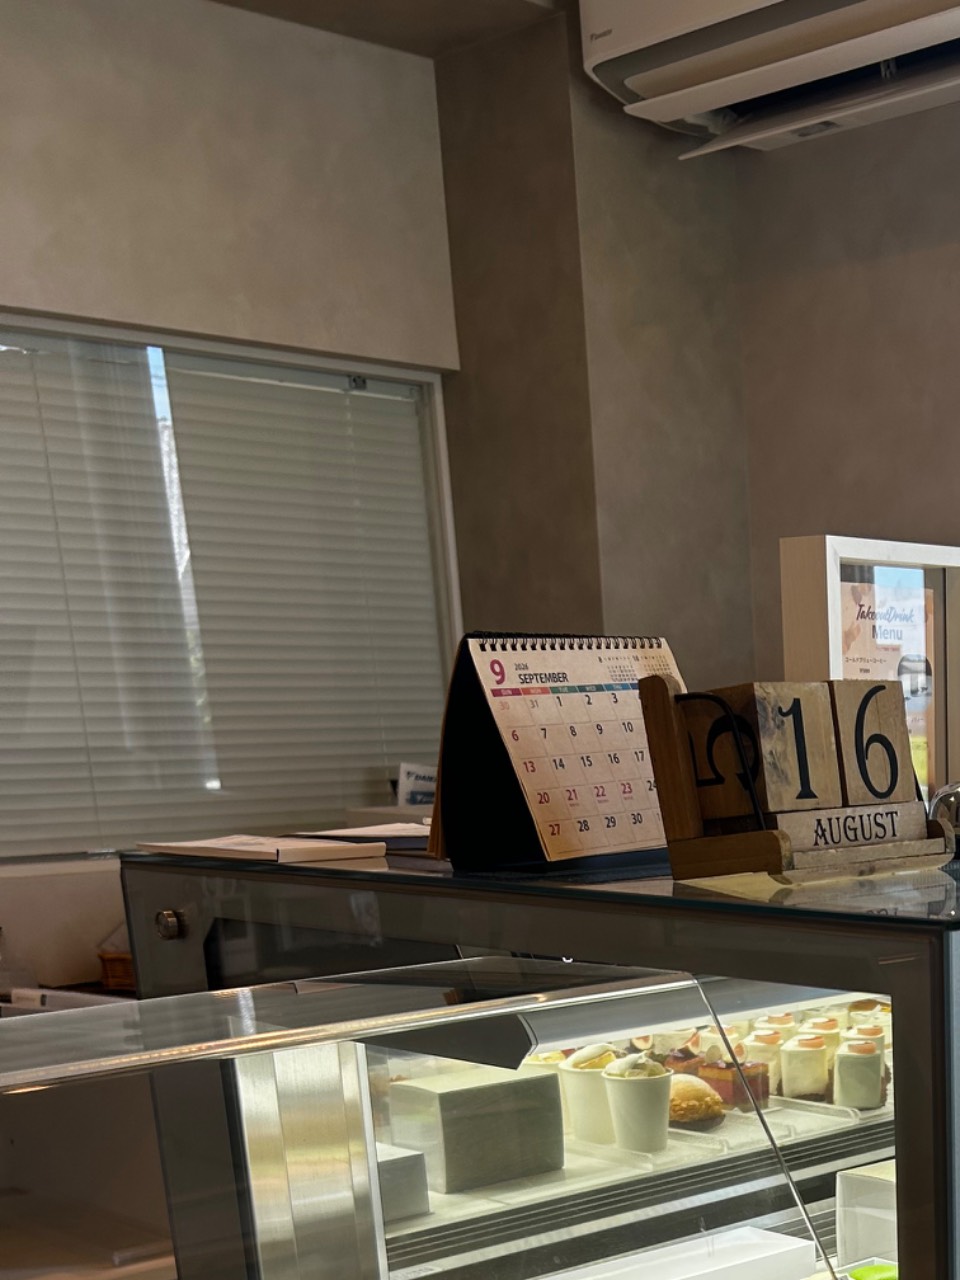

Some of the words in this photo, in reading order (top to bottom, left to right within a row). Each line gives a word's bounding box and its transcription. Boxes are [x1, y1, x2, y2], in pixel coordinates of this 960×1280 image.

[871, 625, 903, 640] Menu
[489, 659, 506, 685] 9
[518, 672, 569, 684] SEPTEMBER
[556, 696, 563, 707] 1
[585, 694, 592, 705] 2
[611, 693, 619, 703] 3
[511, 730, 519, 741] 6
[541, 728, 548, 739] 7
[569, 726, 577, 736] 8
[596, 724, 604, 734] 9
[622, 722, 634, 733] 10
[523, 761, 536, 773] 13
[553, 759, 565, 770] 14
[580, 756, 593, 767] 15
[607, 753, 620, 764] 16
[634, 751, 645, 762] 17
[536, 792, 549, 804] 20
[566, 789, 578, 801] 21
[594, 786, 606, 797] 22
[620, 783, 633, 794] 23
[548, 824, 561, 836] 27
[577, 820, 590, 832] 28
[604, 817, 617, 828] 29
[631, 813, 643, 825] 30
[813, 811, 899, 847] AUGUST
